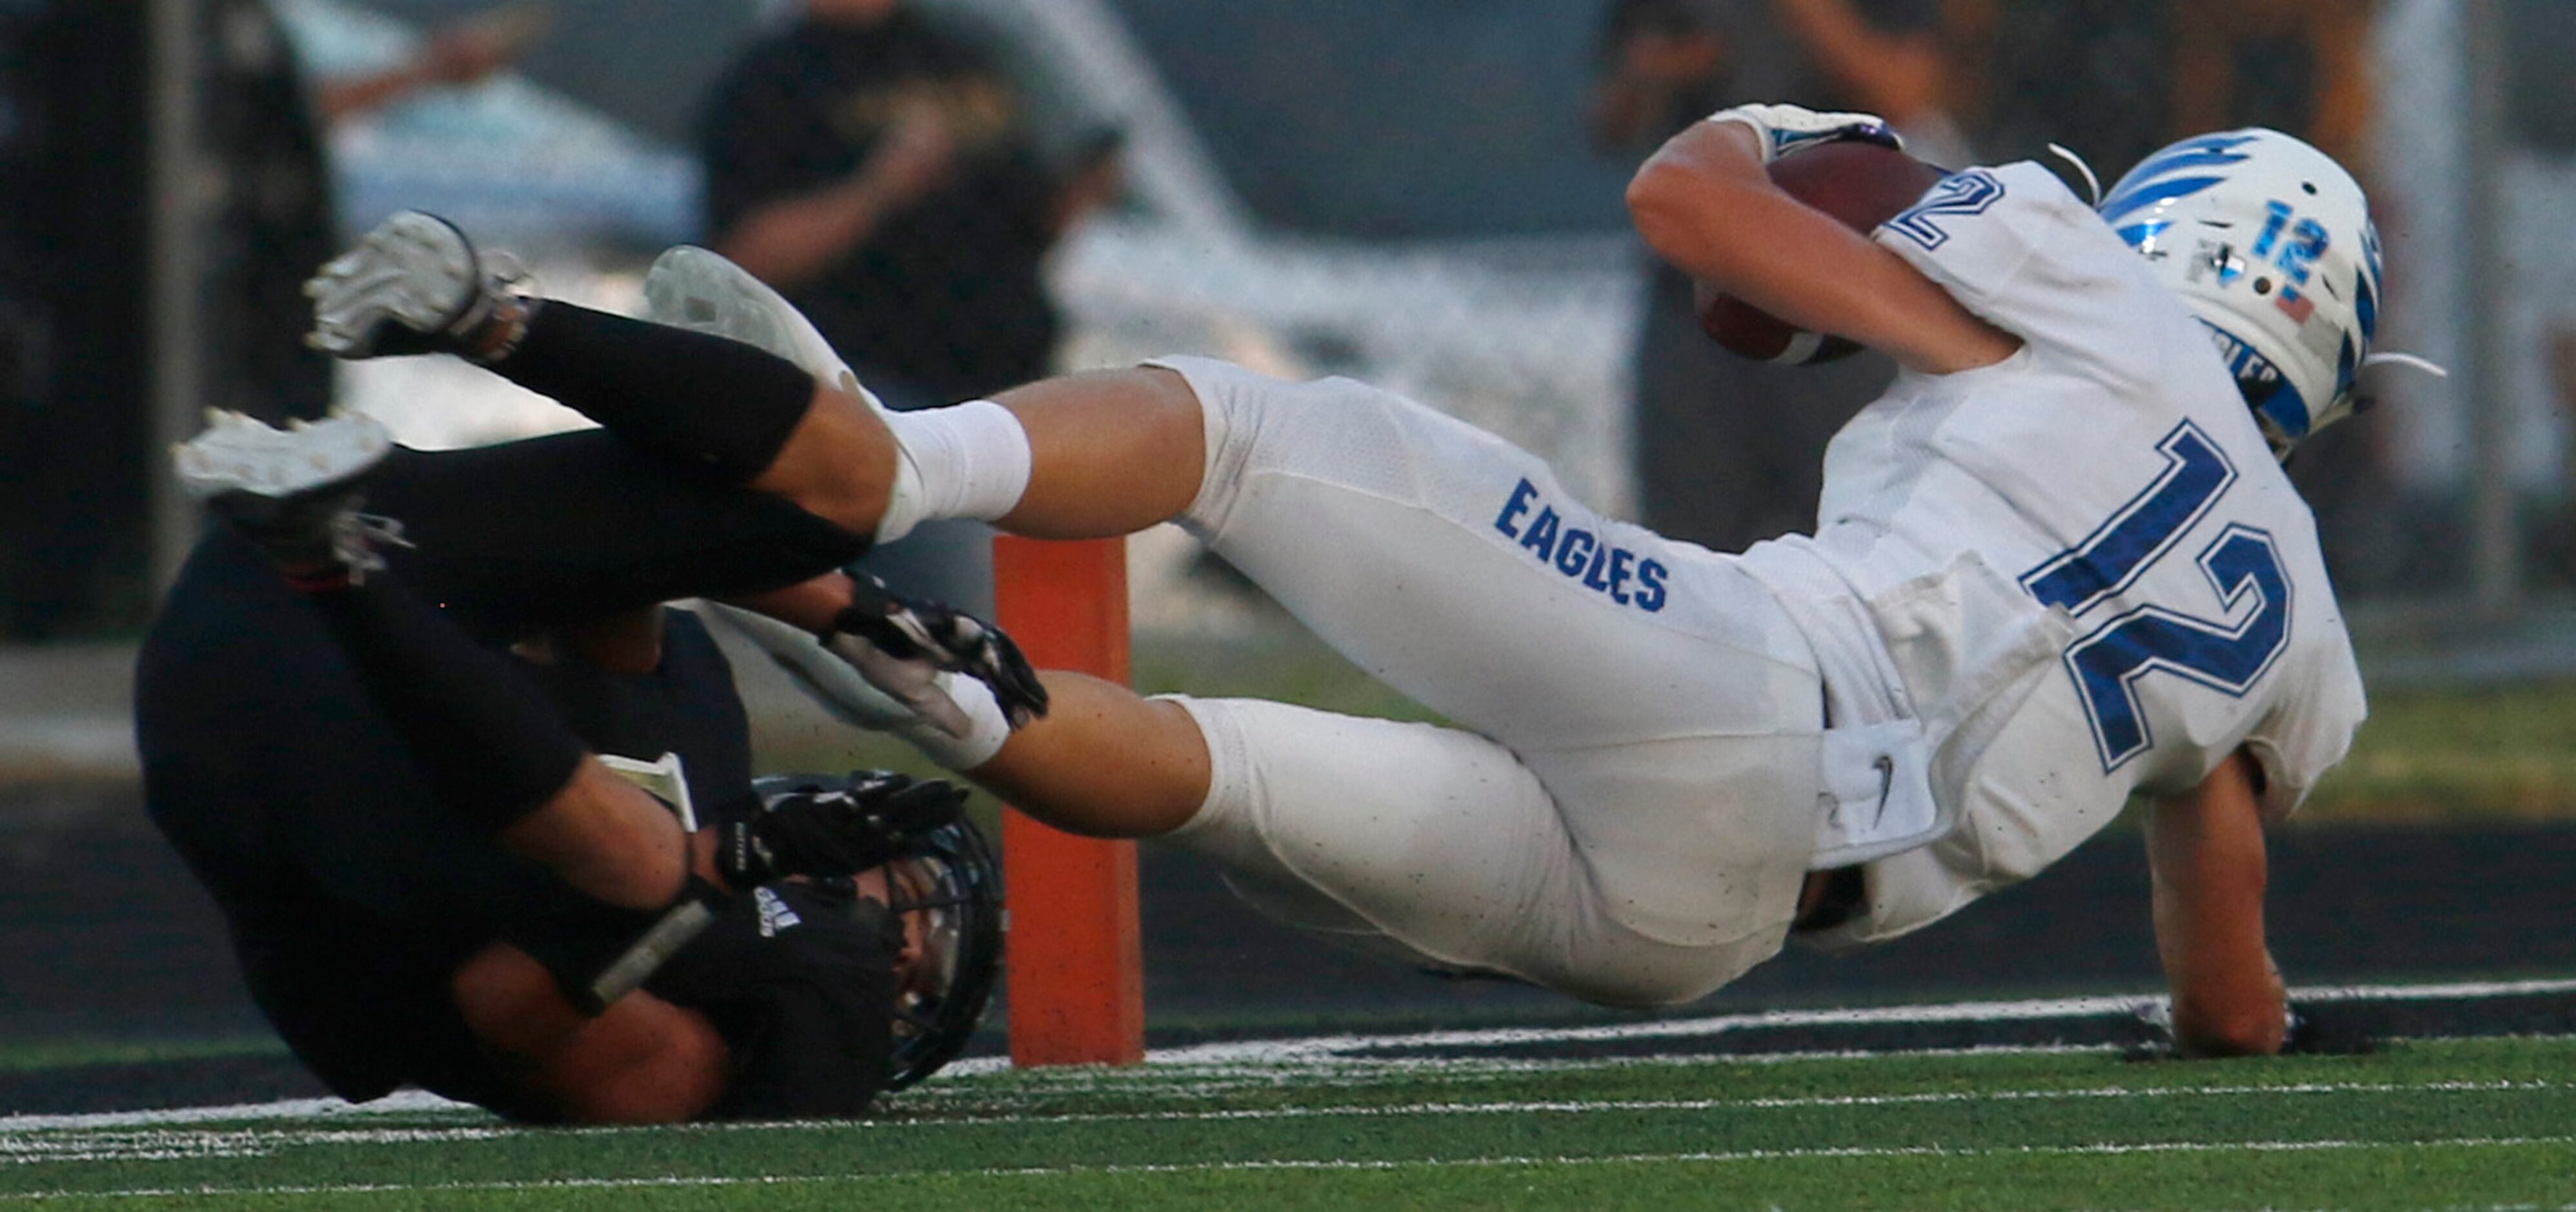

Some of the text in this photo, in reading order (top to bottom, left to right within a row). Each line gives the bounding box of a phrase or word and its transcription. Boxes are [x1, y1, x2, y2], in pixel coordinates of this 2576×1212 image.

[2253, 199, 2329, 285] 12
[1494, 476, 1668, 612] EAGLES
[2017, 416, 2293, 774] 12
